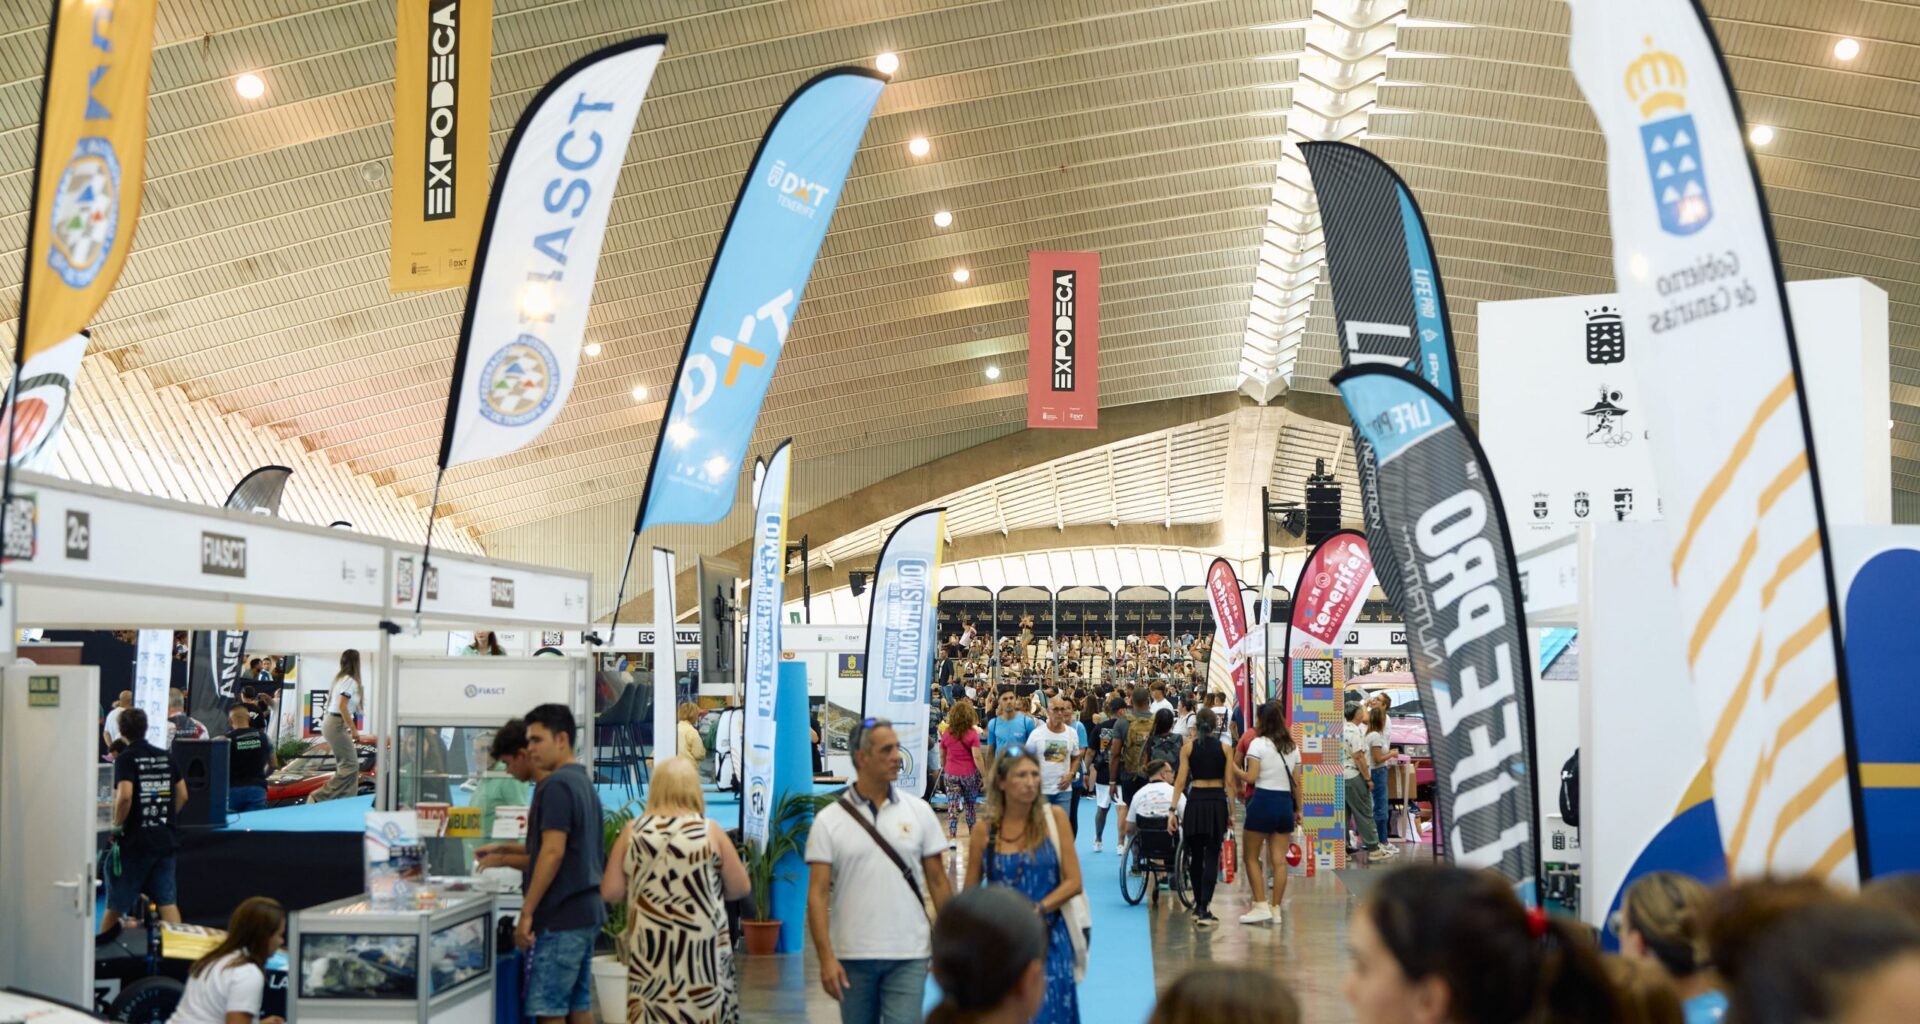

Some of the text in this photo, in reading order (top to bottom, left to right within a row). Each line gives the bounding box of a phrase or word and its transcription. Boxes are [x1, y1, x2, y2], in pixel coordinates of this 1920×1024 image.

[428, 2, 457, 216] EXPODECA
[781, 172, 829, 207] DXT
[679, 289, 794, 415] DXT
[1054, 273, 1074, 389] EXPODECA
[202, 536, 246, 570] FIASCT
[893, 564, 926, 698] AUTOMOVILISMO
